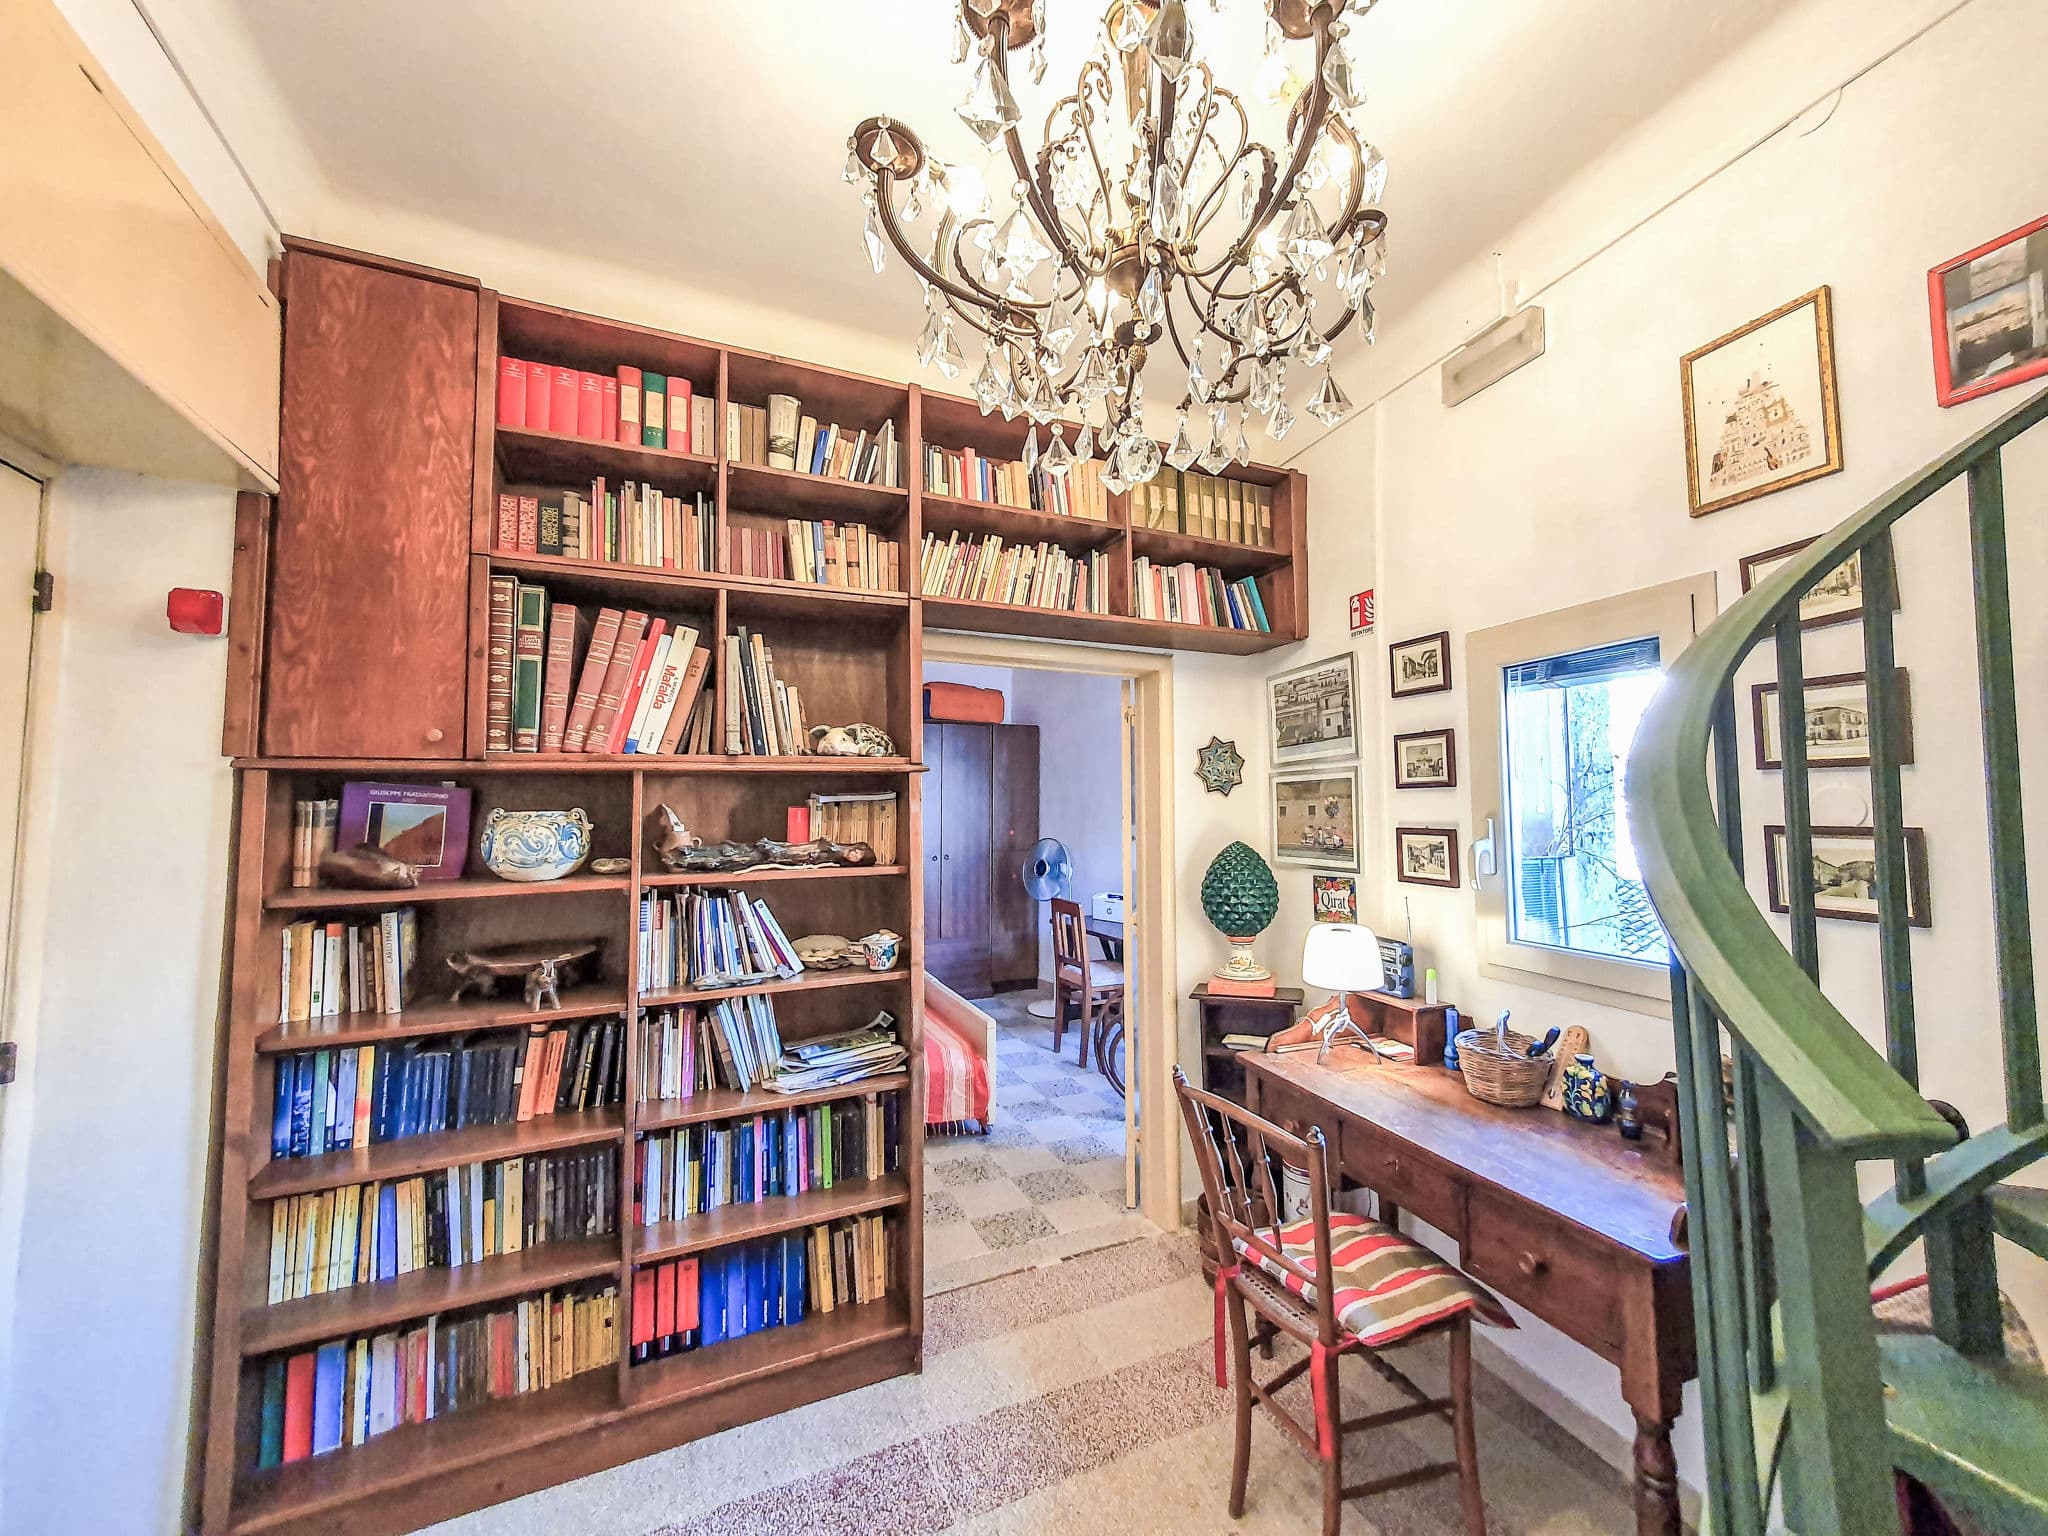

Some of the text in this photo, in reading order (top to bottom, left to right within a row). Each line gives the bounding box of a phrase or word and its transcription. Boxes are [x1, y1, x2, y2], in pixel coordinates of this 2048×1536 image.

[1351, 626, 1374, 638] ESTINTORE
[653, 664, 678, 710] Mafalda
[369, 789, 402, 797] GIUSEPPE
[1321, 891, 1347, 910] Qirat
[385, 915, 393, 964] CARLO MAGNO
